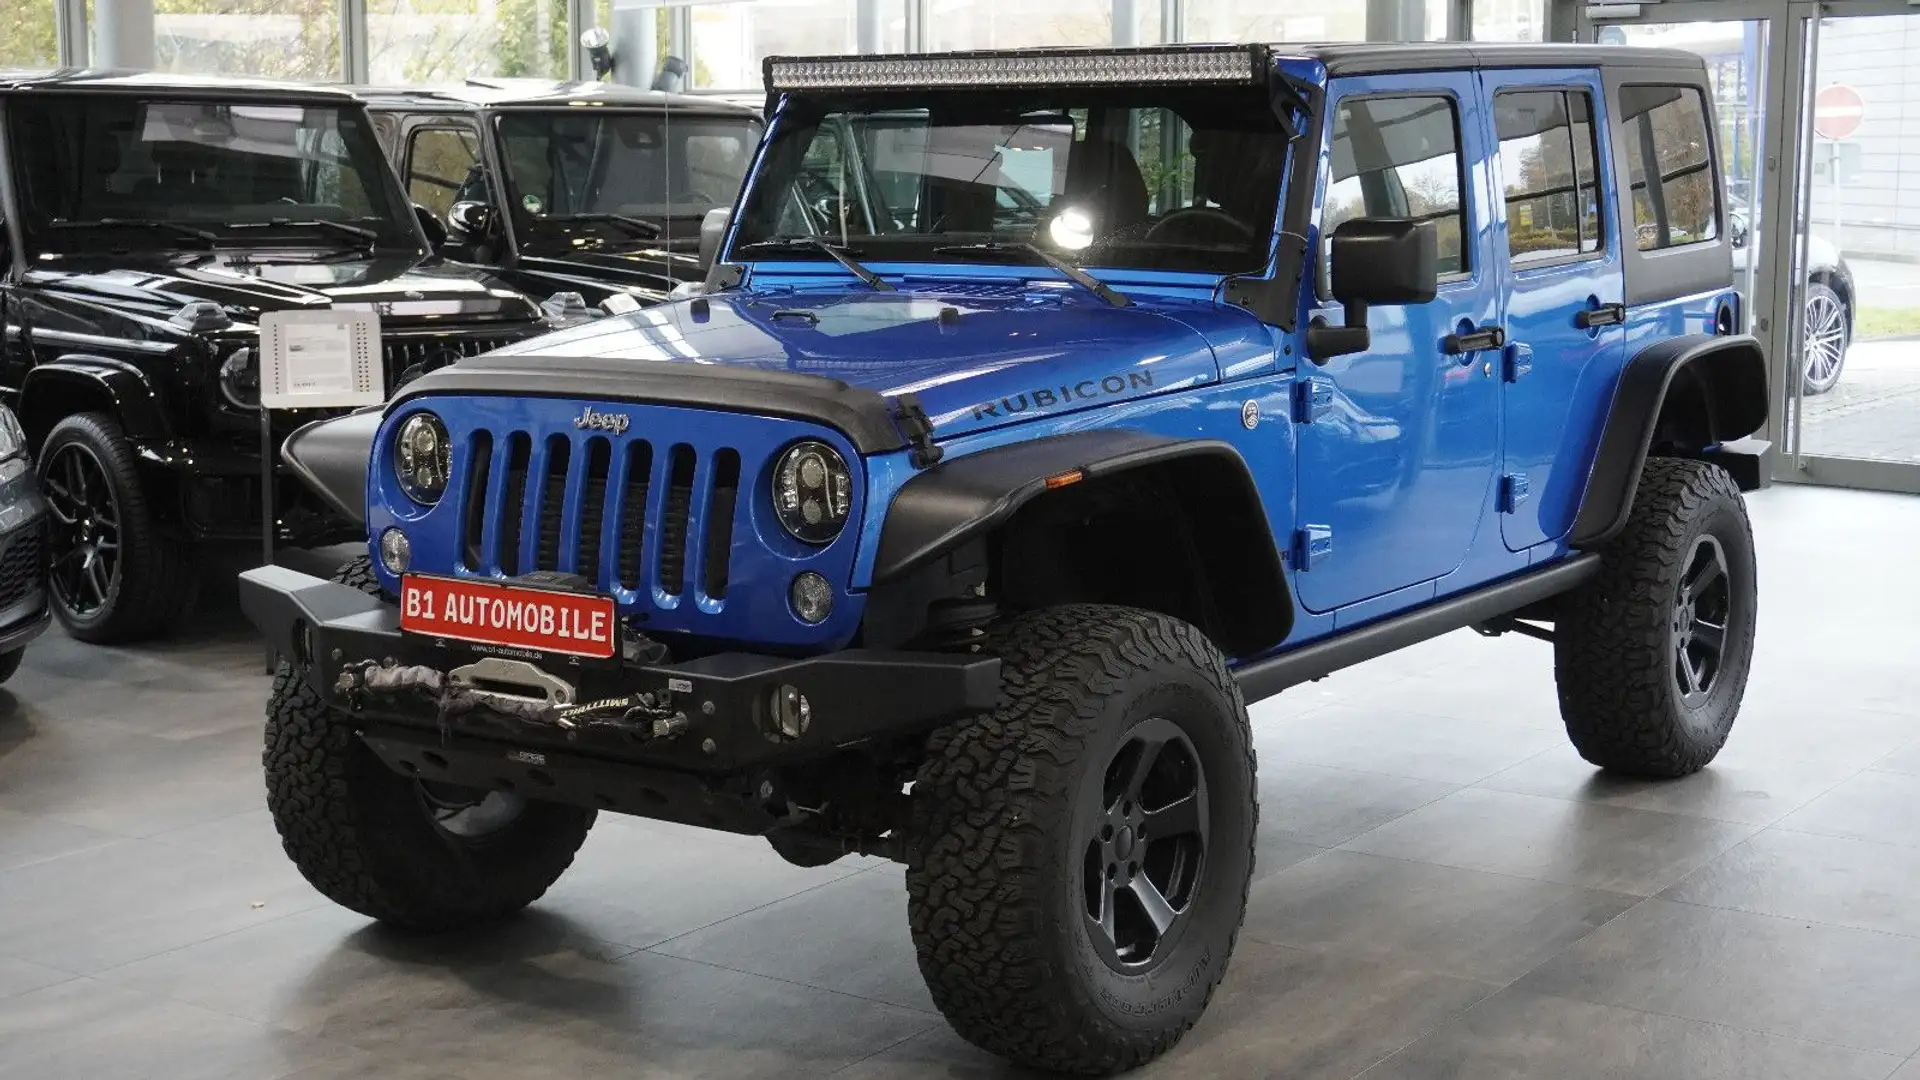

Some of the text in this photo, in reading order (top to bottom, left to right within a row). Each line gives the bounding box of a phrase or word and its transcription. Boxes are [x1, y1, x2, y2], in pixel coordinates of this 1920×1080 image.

[972, 370, 1153, 420] RUBICON
[574, 406, 629, 435] Jeep
[406, 588, 606, 642] B1 AUTOMOBILE
